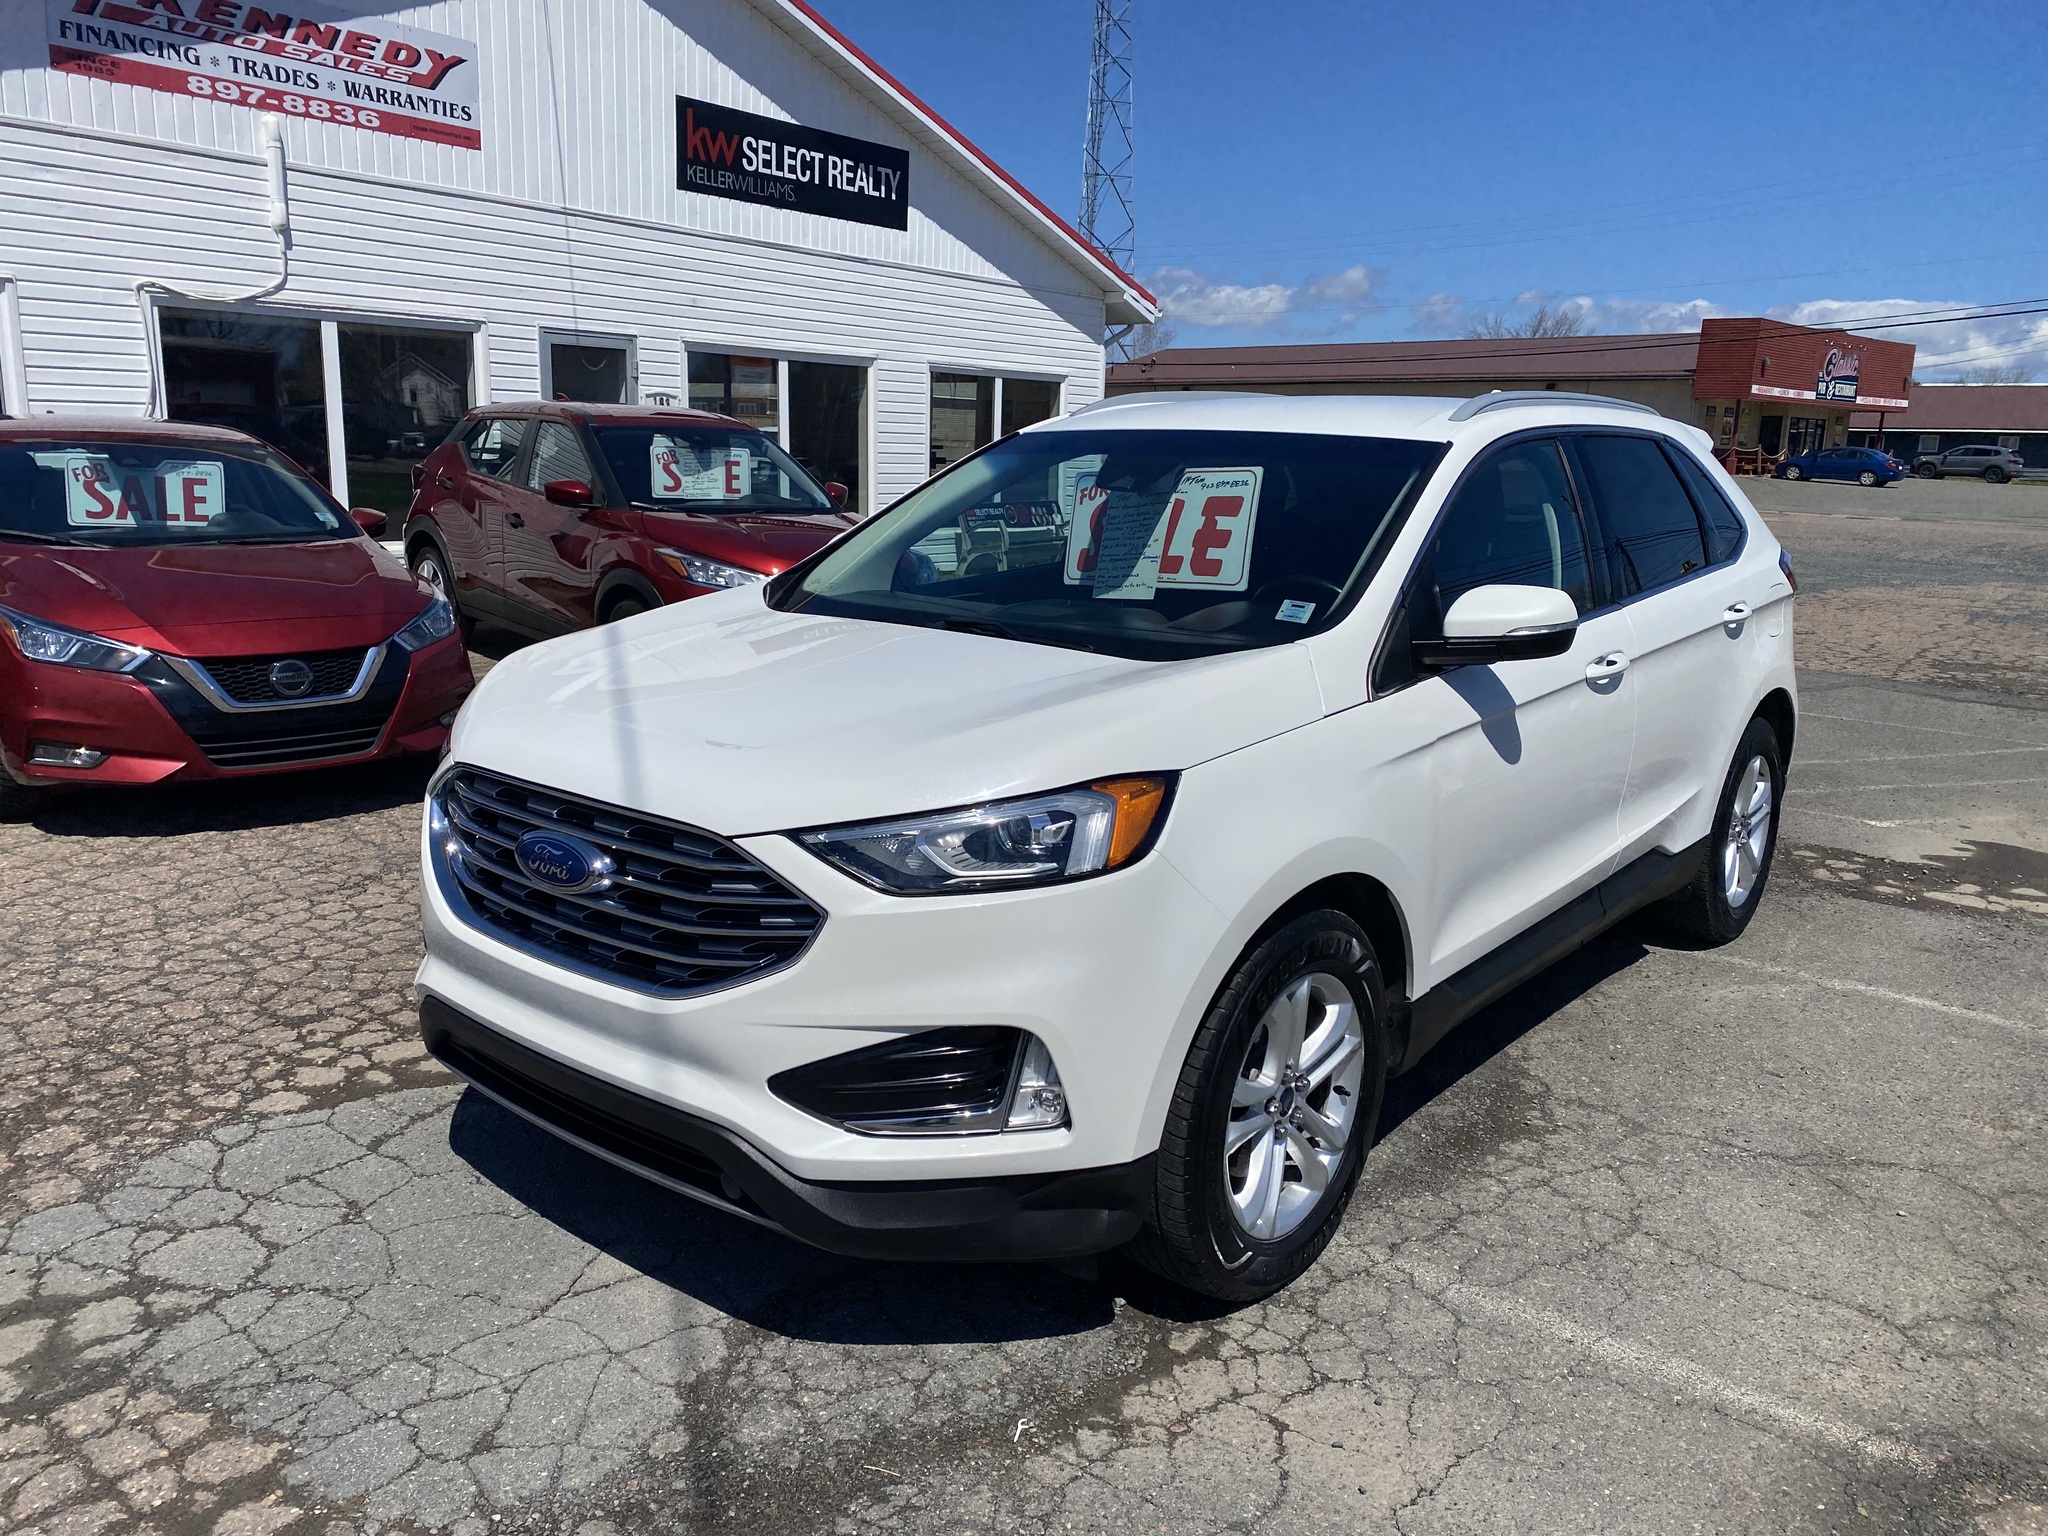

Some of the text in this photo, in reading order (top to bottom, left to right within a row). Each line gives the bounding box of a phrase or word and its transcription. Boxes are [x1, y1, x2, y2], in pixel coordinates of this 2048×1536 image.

[66, 52, 121, 69] SINCE
[73, 63, 115, 76] 1985
[140, 14, 413, 83] AUTO SALES
[58, 19, 472, 121] FINANCING TRADES WARRANTIES
[187, 75, 381, 128] 897-8836
[686, 107, 739, 166] kw
[742, 136, 901, 201] SELECT REALTY
[71, 462, 106, 483] FOR
[655, 450, 679, 465] FOR
[662, 460, 741, 494] SE
[83, 474, 209, 522] SALE
[1077, 496, 1244, 577] SLE
[277, 672, 310, 682] NISSAN
[528, 843, 573, 880] Ford
